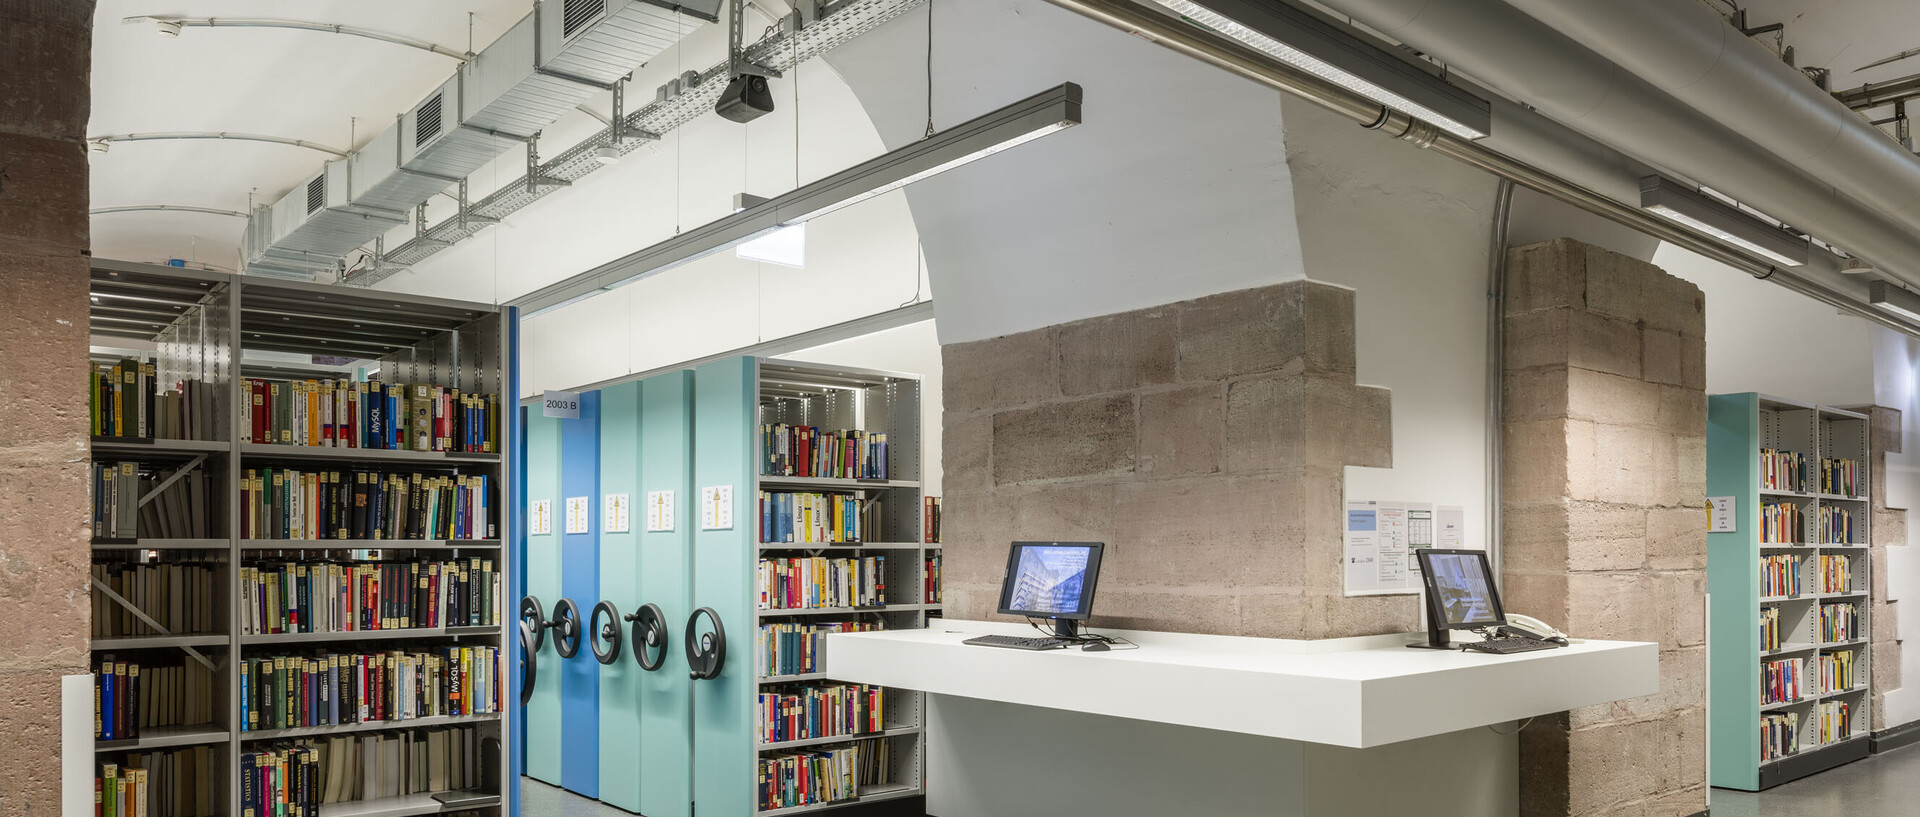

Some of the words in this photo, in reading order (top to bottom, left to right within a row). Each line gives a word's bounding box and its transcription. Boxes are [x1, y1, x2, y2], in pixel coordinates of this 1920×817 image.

[546, 399, 568, 410] 2003
[570, 401, 577, 410] B
[371, 407, 381, 433] MySQL
[450, 665, 460, 693] MySQL
